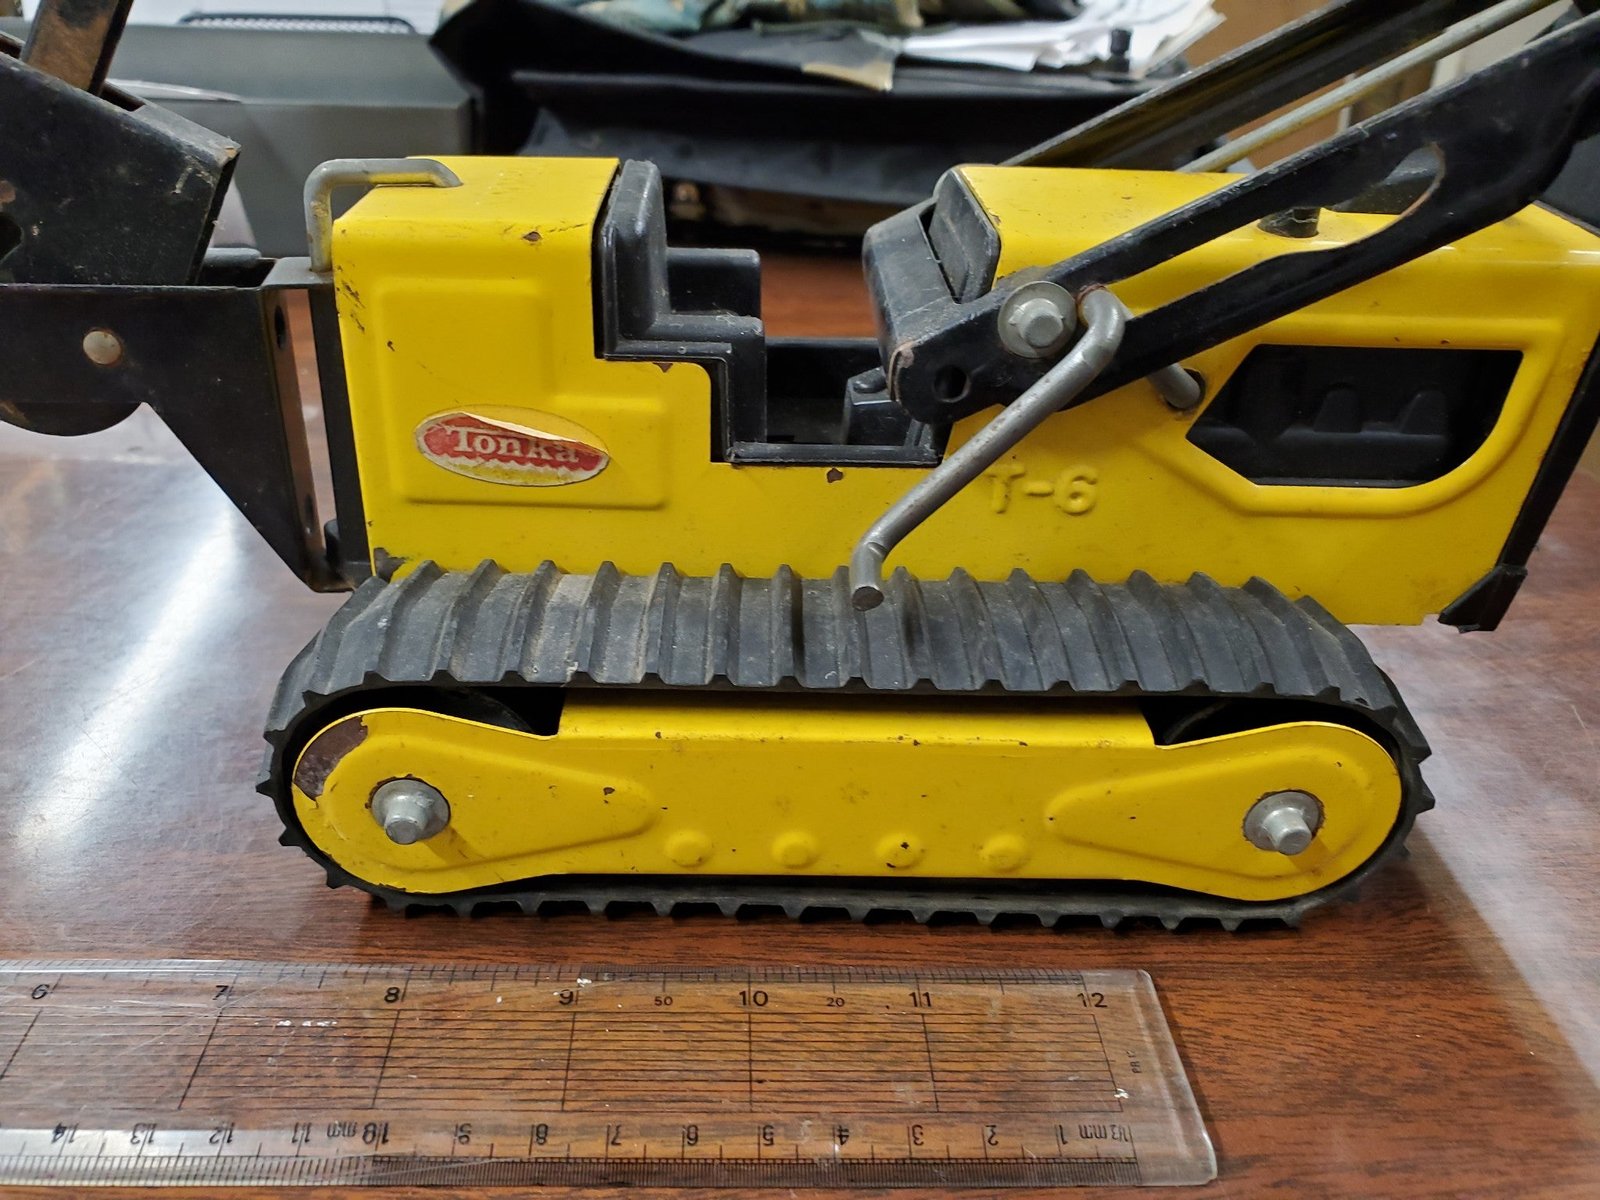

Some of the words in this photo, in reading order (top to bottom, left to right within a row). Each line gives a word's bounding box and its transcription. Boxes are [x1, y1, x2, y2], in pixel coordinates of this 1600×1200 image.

[447, 426, 579, 463] Tonka
[986, 463, 1098, 516] T-6
[32, 984, 50, 999] 6
[213, 985, 229, 1000] 7
[384, 987, 400, 1003] 8
[559, 990, 574, 1005] 9
[654, 996, 673, 1007] 50
[739, 990, 768, 1006] 10
[827, 997, 845, 1008] 20
[908, 992, 931, 1007] 11
[1078, 992, 1108, 1008] 12
[51, 1122, 79, 1144] 14
[131, 1122, 156, 1144] 13
[209, 1122, 234, 1144] 12
[292, 1122, 311, 1143] 11
[362, 1122, 389, 1145] 10
[457, 1123, 472, 1145] 9
[535, 1123, 548, 1145] 8
[610, 1124, 622, 1145] 7
[686, 1124, 698, 1145] 6
[763, 1124, 774, 1145] 5
[836, 1125, 849, 1146] 4
[912, 1124, 924, 1145] 3
[986, 1125, 998, 1146] 2
[1078, 1124, 1107, 1140] mm
